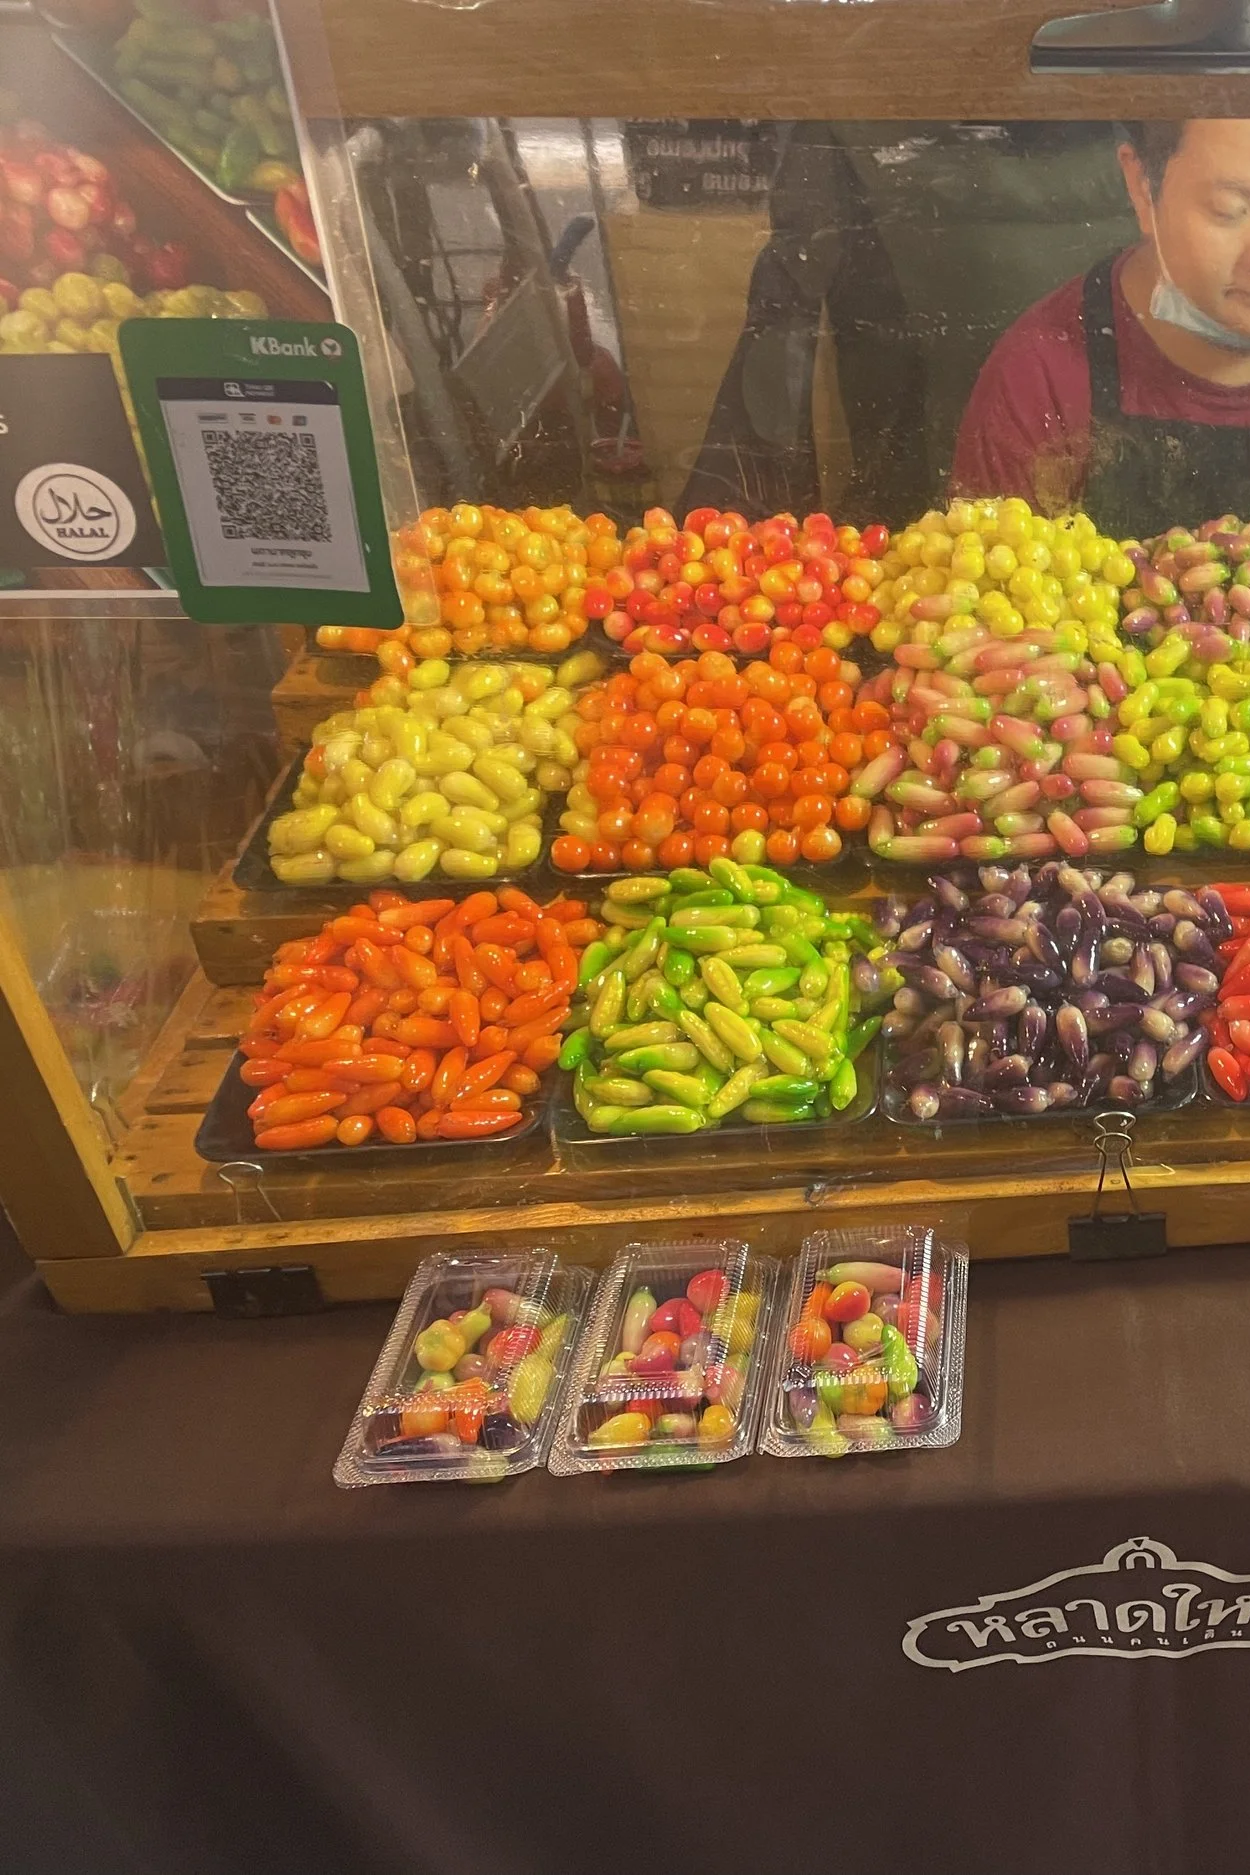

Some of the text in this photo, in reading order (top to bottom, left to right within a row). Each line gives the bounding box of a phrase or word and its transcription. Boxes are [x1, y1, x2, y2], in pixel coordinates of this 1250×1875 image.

[249, 336, 318, 357] KBank
[40, 488, 112, 525] حلال
[56, 527, 110, 538] HALAL
